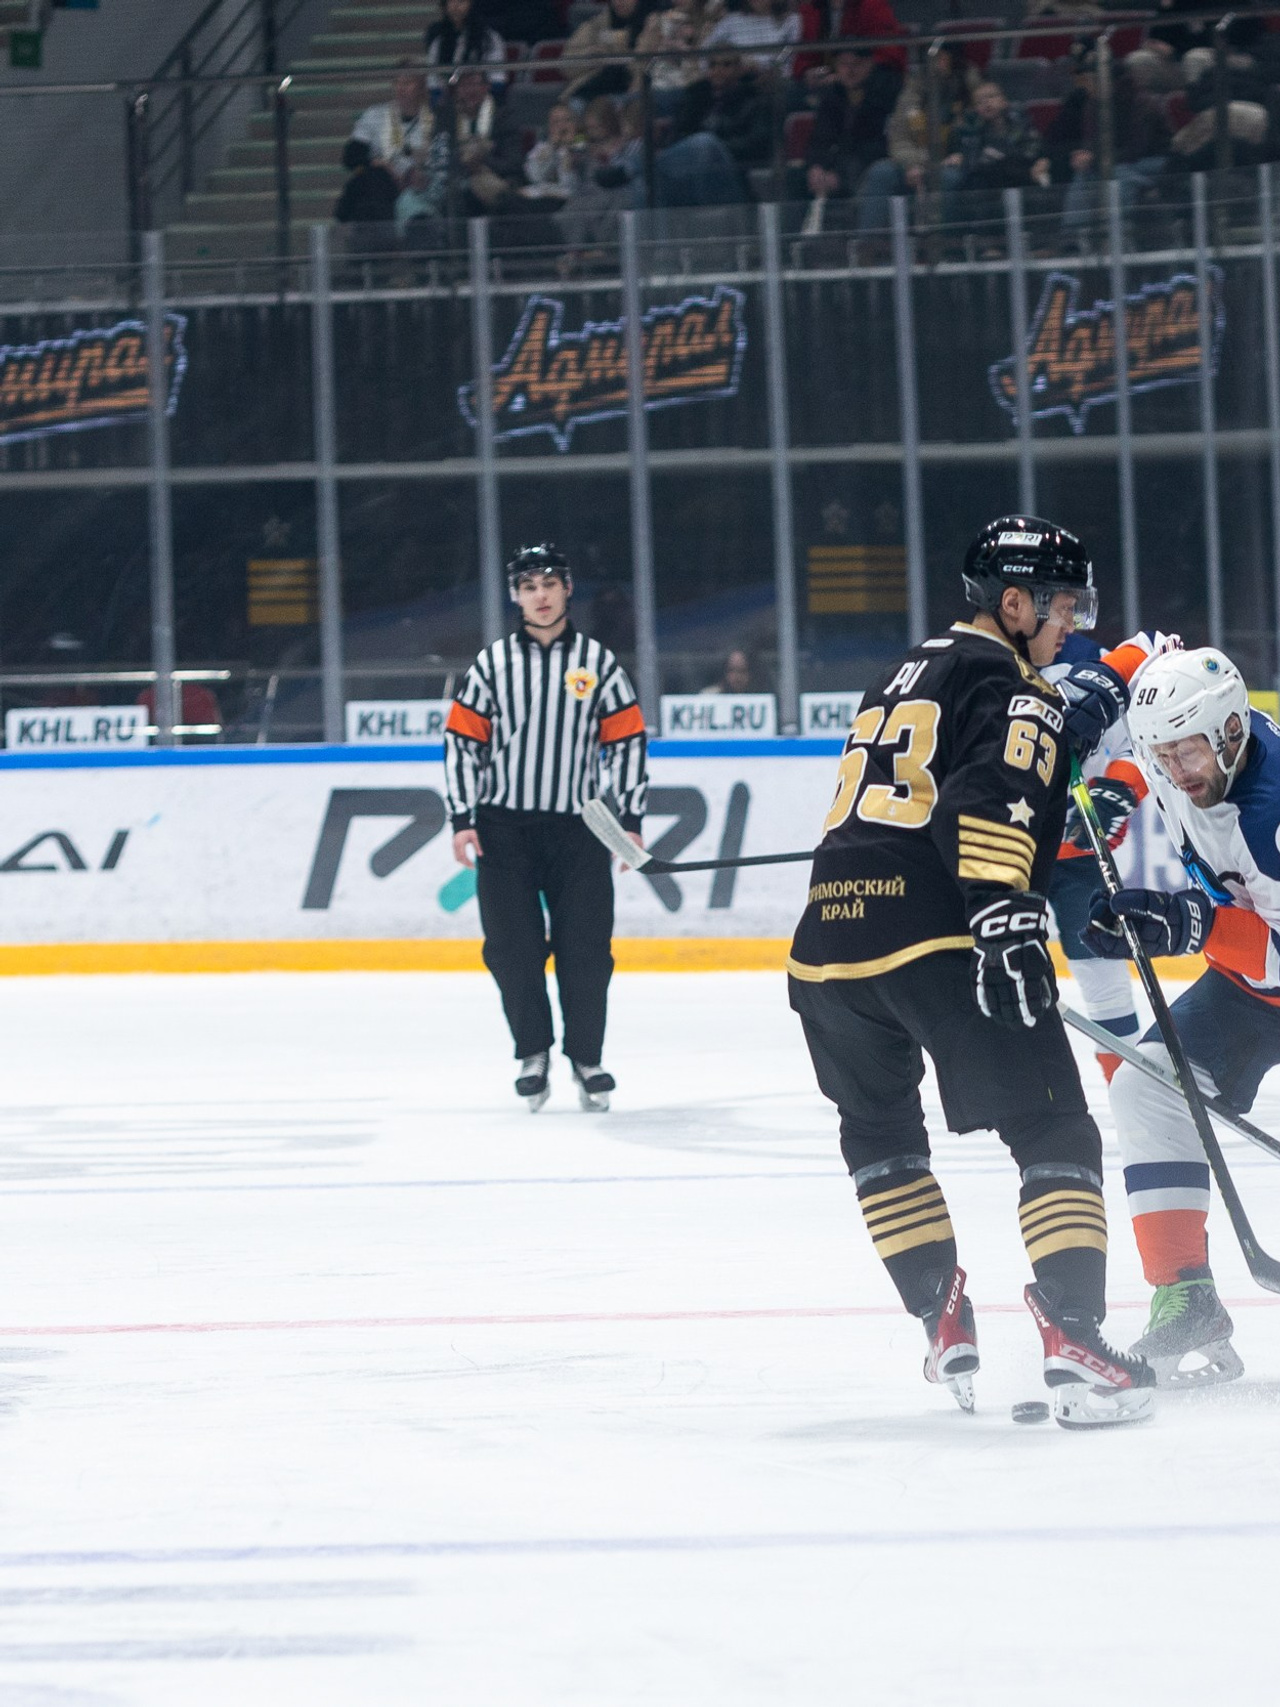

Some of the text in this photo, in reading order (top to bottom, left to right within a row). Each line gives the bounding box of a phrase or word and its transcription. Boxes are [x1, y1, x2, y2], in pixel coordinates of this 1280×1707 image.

[1002, 564, 1034, 573] CCM
[1136, 688, 1158, 706] 90
[17, 714, 138, 745] KHL.RU
[357, 709, 443, 738] KHL.R
[669, 704, 768, 732] KHL.RU
[810, 702, 853, 728] KHL
[1010, 698, 1064, 732] PARI
[823, 699, 942, 829] 63
[1004, 718, 1057, 787] 63
[1088, 787, 1134, 813] CCM
[302, 779, 752, 912] PRI
[821, 898, 866, 922] КРАЙ
[1185, 898, 1203, 956] BAU
[945, 1273, 962, 1316] CCM
[1026, 1296, 1050, 1329] CCM
[1058, 1343, 1130, 1384] CCM
